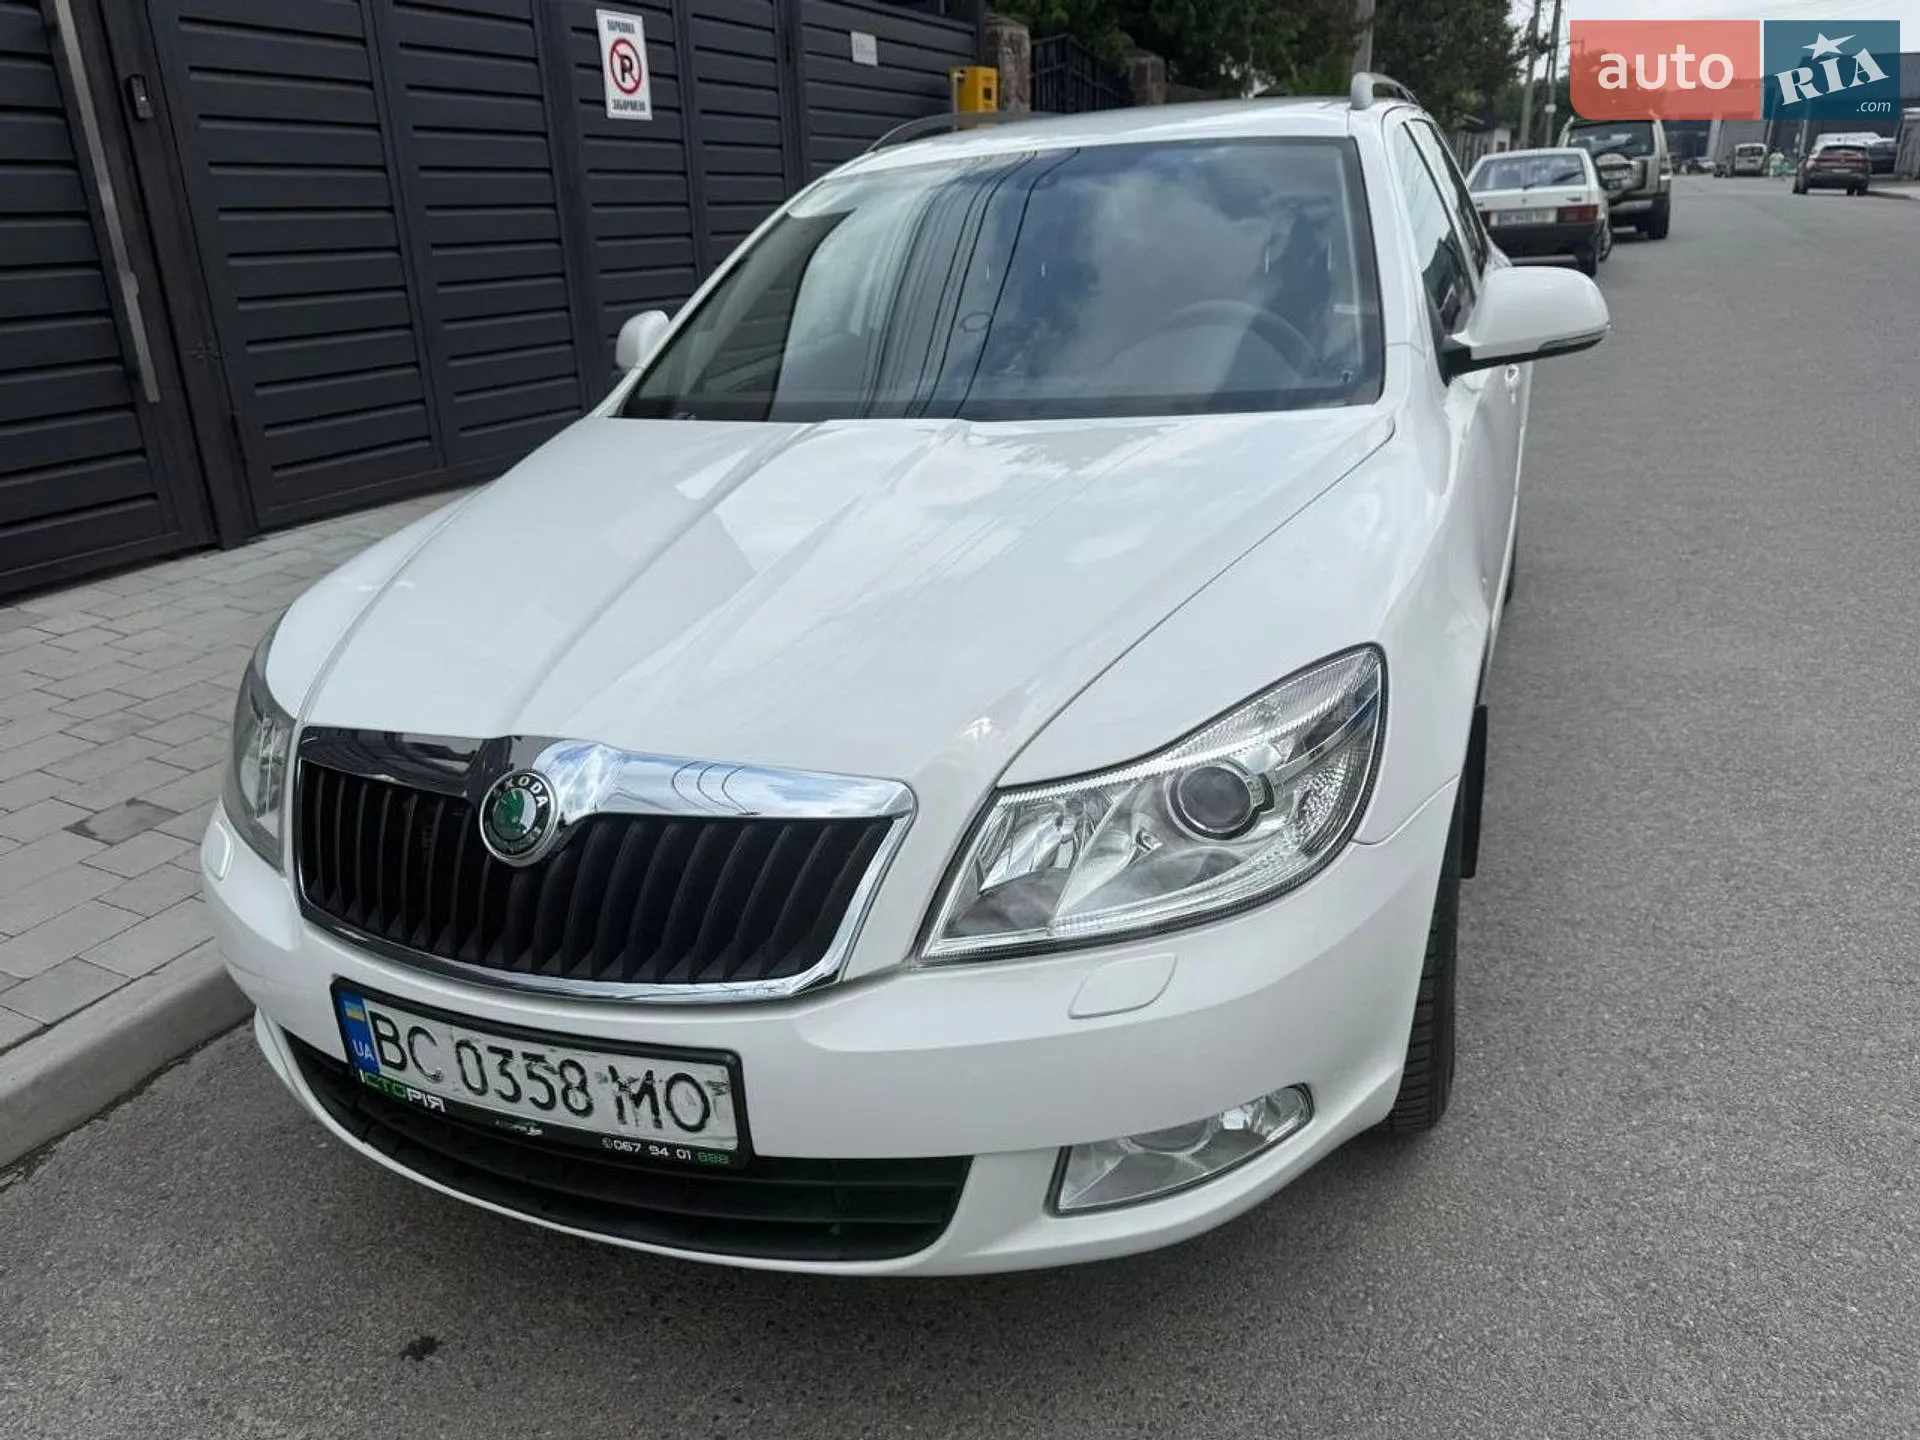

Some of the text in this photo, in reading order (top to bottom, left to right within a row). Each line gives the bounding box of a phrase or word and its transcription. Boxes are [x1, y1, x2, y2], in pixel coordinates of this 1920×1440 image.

[352, 1039, 375, 1062] UA
[369, 1010, 711, 1133] BC 0358 MO
[648, 1145, 669, 1158] 94
[676, 1148, 692, 1161] 01
